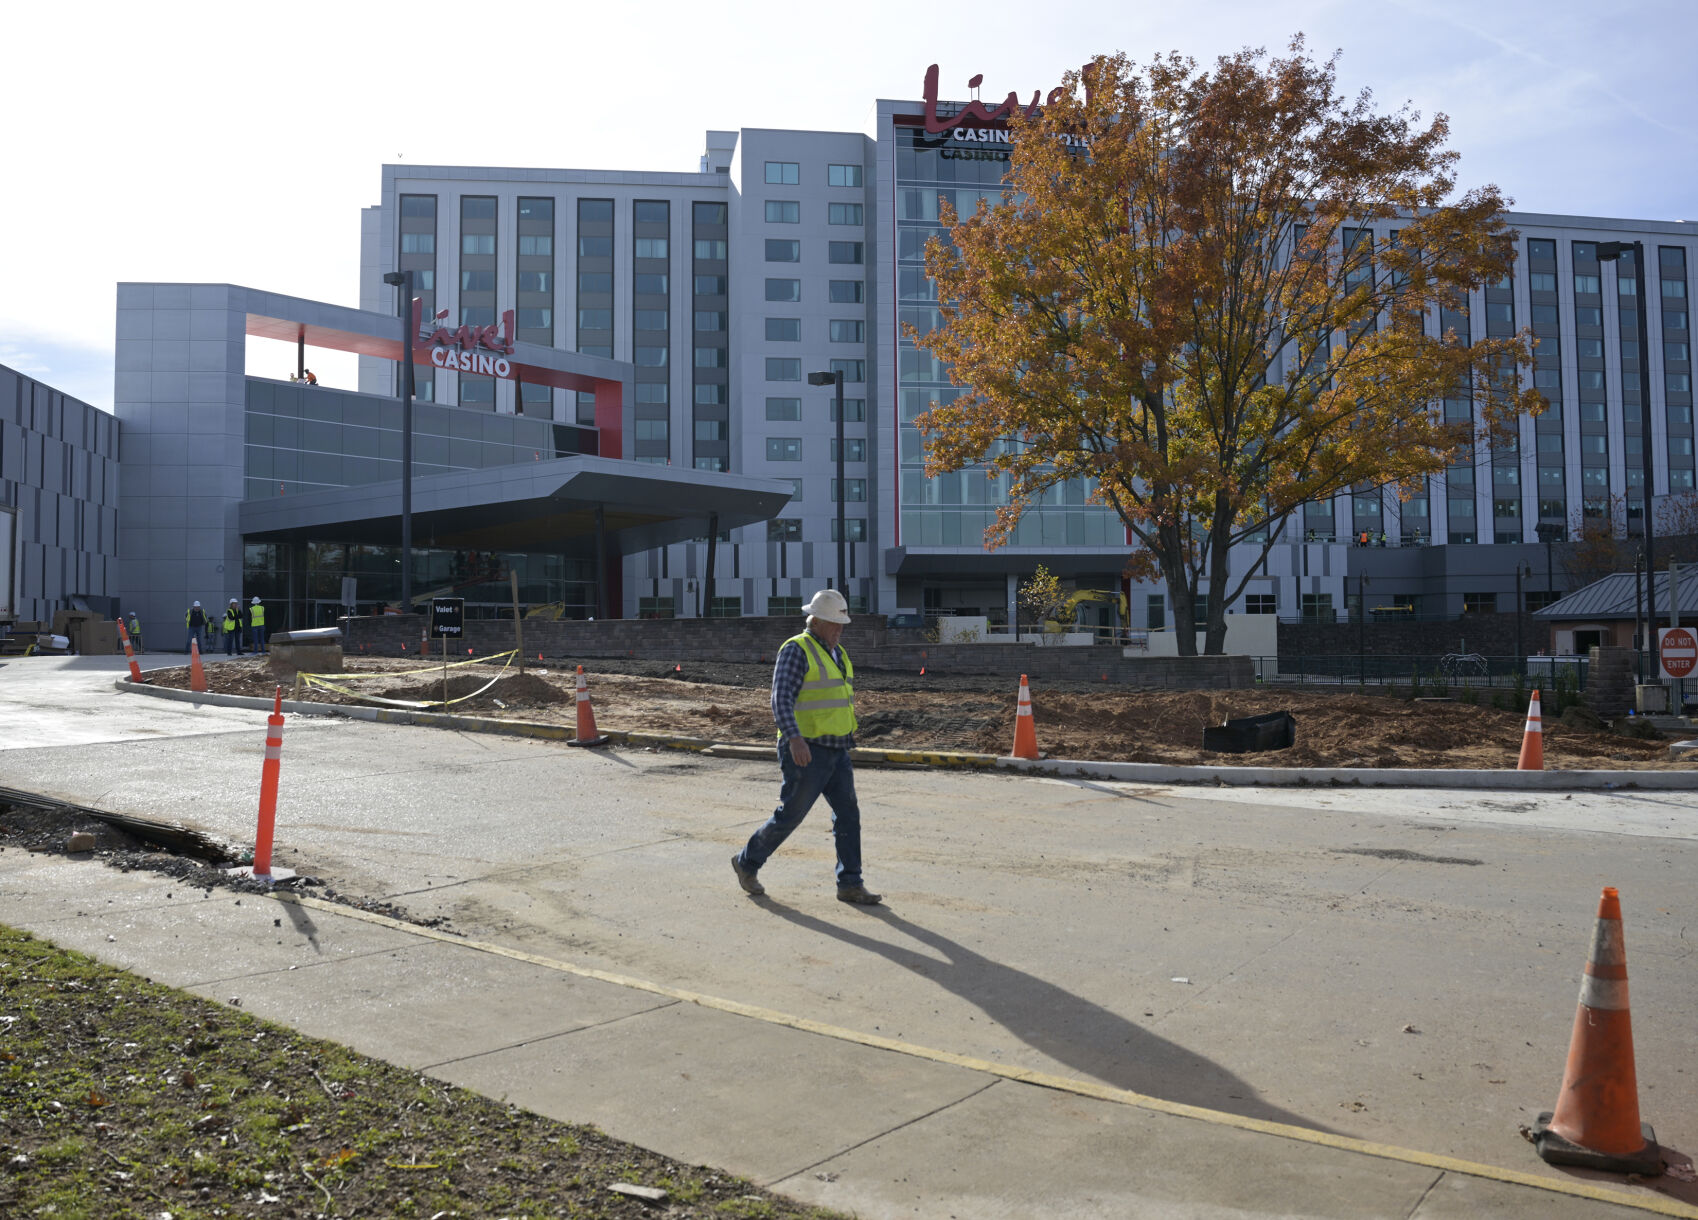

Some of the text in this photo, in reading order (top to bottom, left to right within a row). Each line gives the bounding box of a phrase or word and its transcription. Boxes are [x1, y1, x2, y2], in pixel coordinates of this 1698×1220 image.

[412, 296, 515, 355] Live!
[431, 346, 511, 377] CASINO
[435, 605, 453, 613] Valet
[439, 625, 461, 633] Garage
[1665, 637, 1692, 646] DO NOT
[1667, 660, 1691, 669] ENTER
